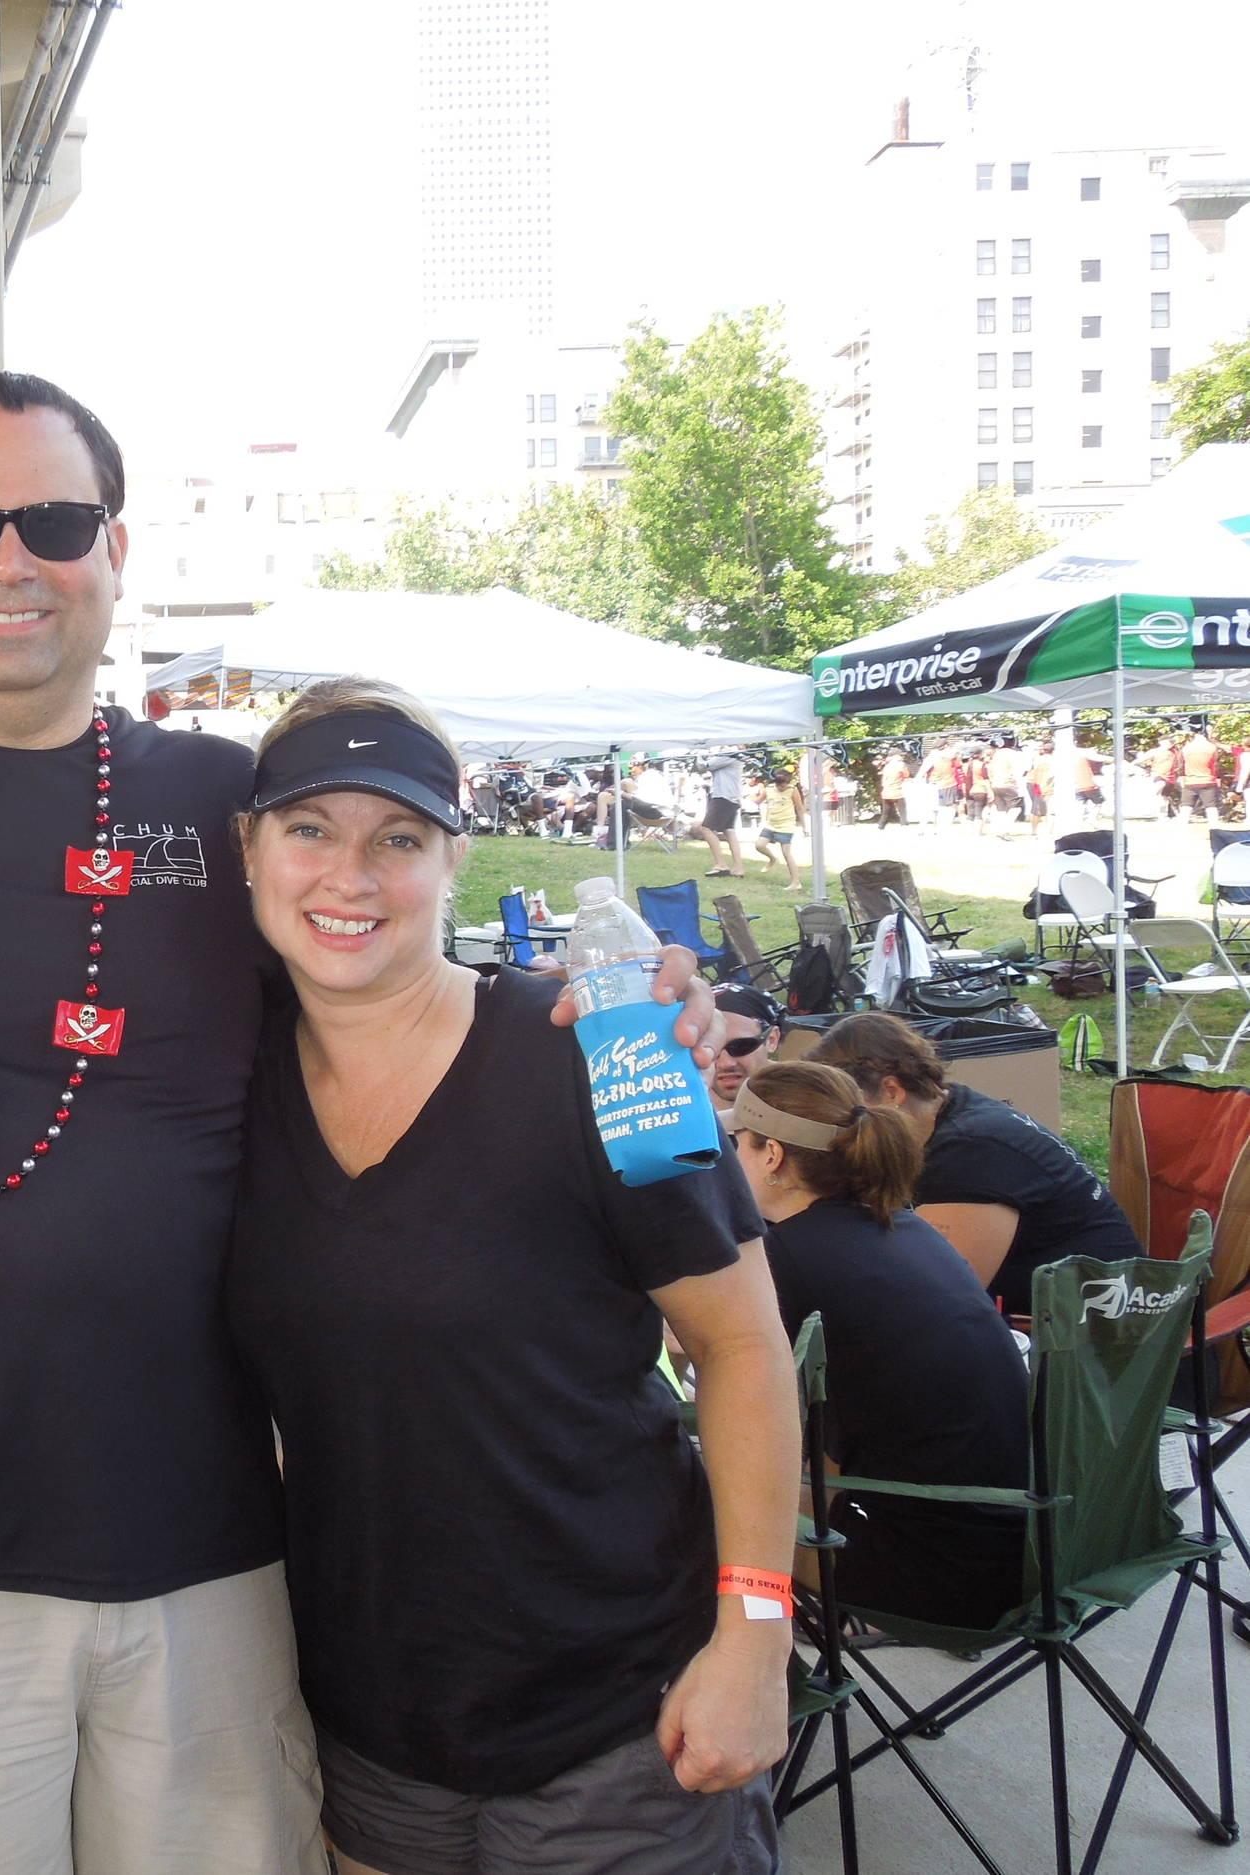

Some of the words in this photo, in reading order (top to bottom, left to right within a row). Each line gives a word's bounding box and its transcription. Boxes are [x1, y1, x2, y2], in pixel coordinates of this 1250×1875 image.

[814, 643, 981, 698] enterprise
[915, 676, 982, 697] rent-a-car
[113, 823, 198, 838] CHUM
[130, 877, 154, 887] CIAL
[156, 875, 180, 885] DIVE
[183, 877, 207, 888] CLUB
[611, 1031, 658, 1063] Carts
[622, 1049, 669, 1078] Texas
[636, 1112, 680, 1131] TEXAS
[757, 1579, 786, 1594] Texas
